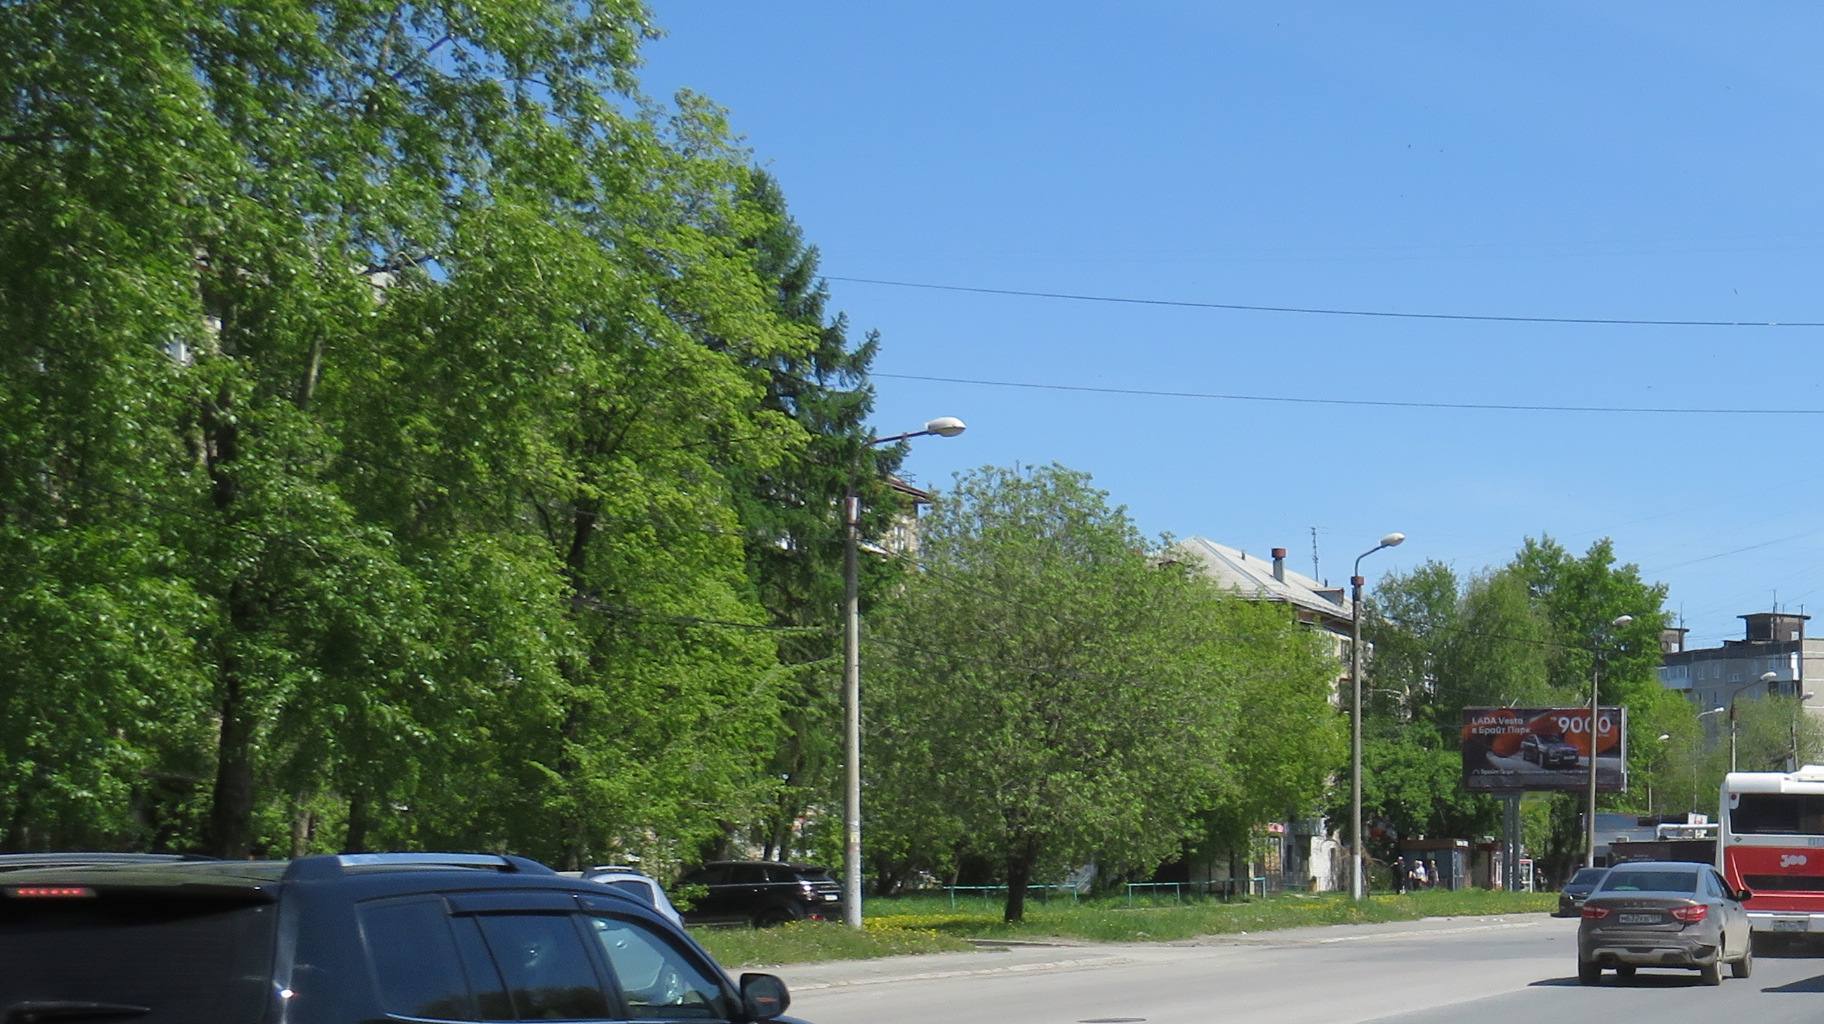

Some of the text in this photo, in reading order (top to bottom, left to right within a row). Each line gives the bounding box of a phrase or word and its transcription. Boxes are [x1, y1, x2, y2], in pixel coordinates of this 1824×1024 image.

[1472, 717, 1524, 725] LADA Vesta
[1780, 855, 1807, 868] 300
